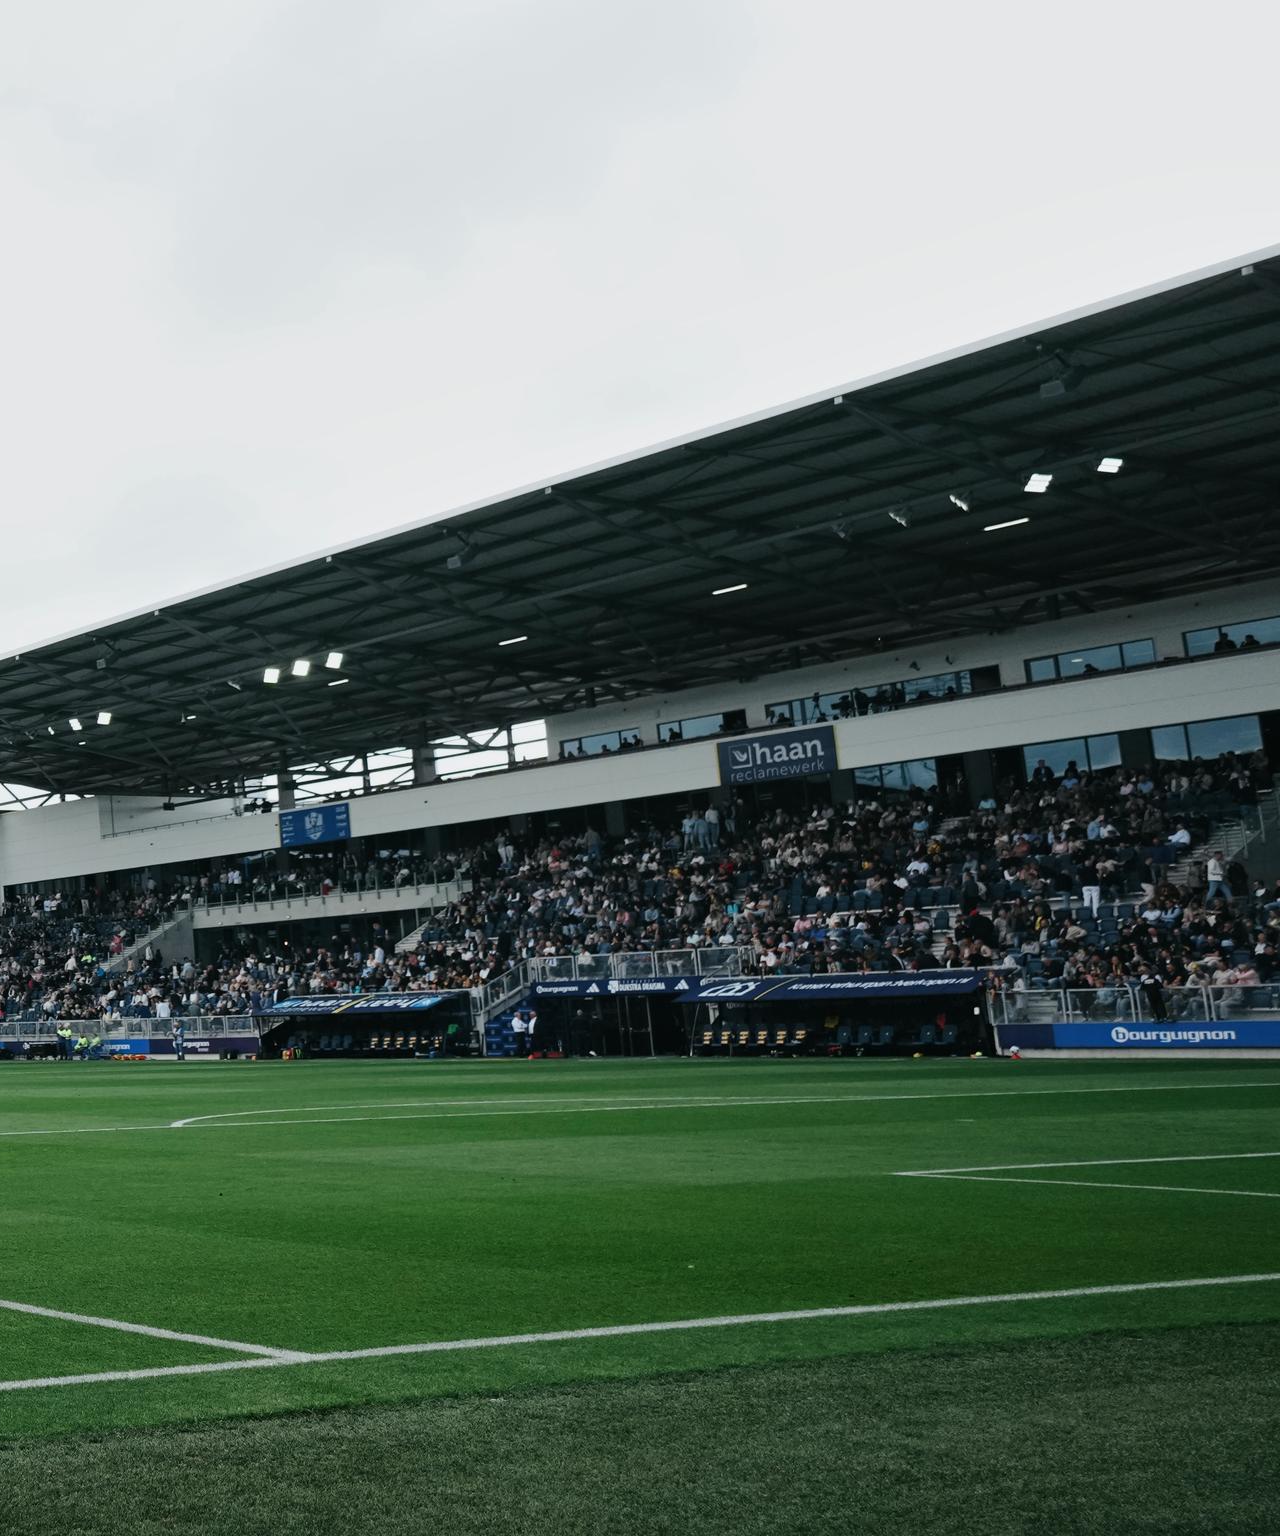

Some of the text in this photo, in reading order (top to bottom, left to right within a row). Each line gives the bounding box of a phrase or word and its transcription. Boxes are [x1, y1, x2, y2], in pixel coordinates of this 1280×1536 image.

[753, 739, 825, 765] haan
[730, 759, 825, 782] reclamewerk
[1111, 1026, 1236, 1043] bourguignon
